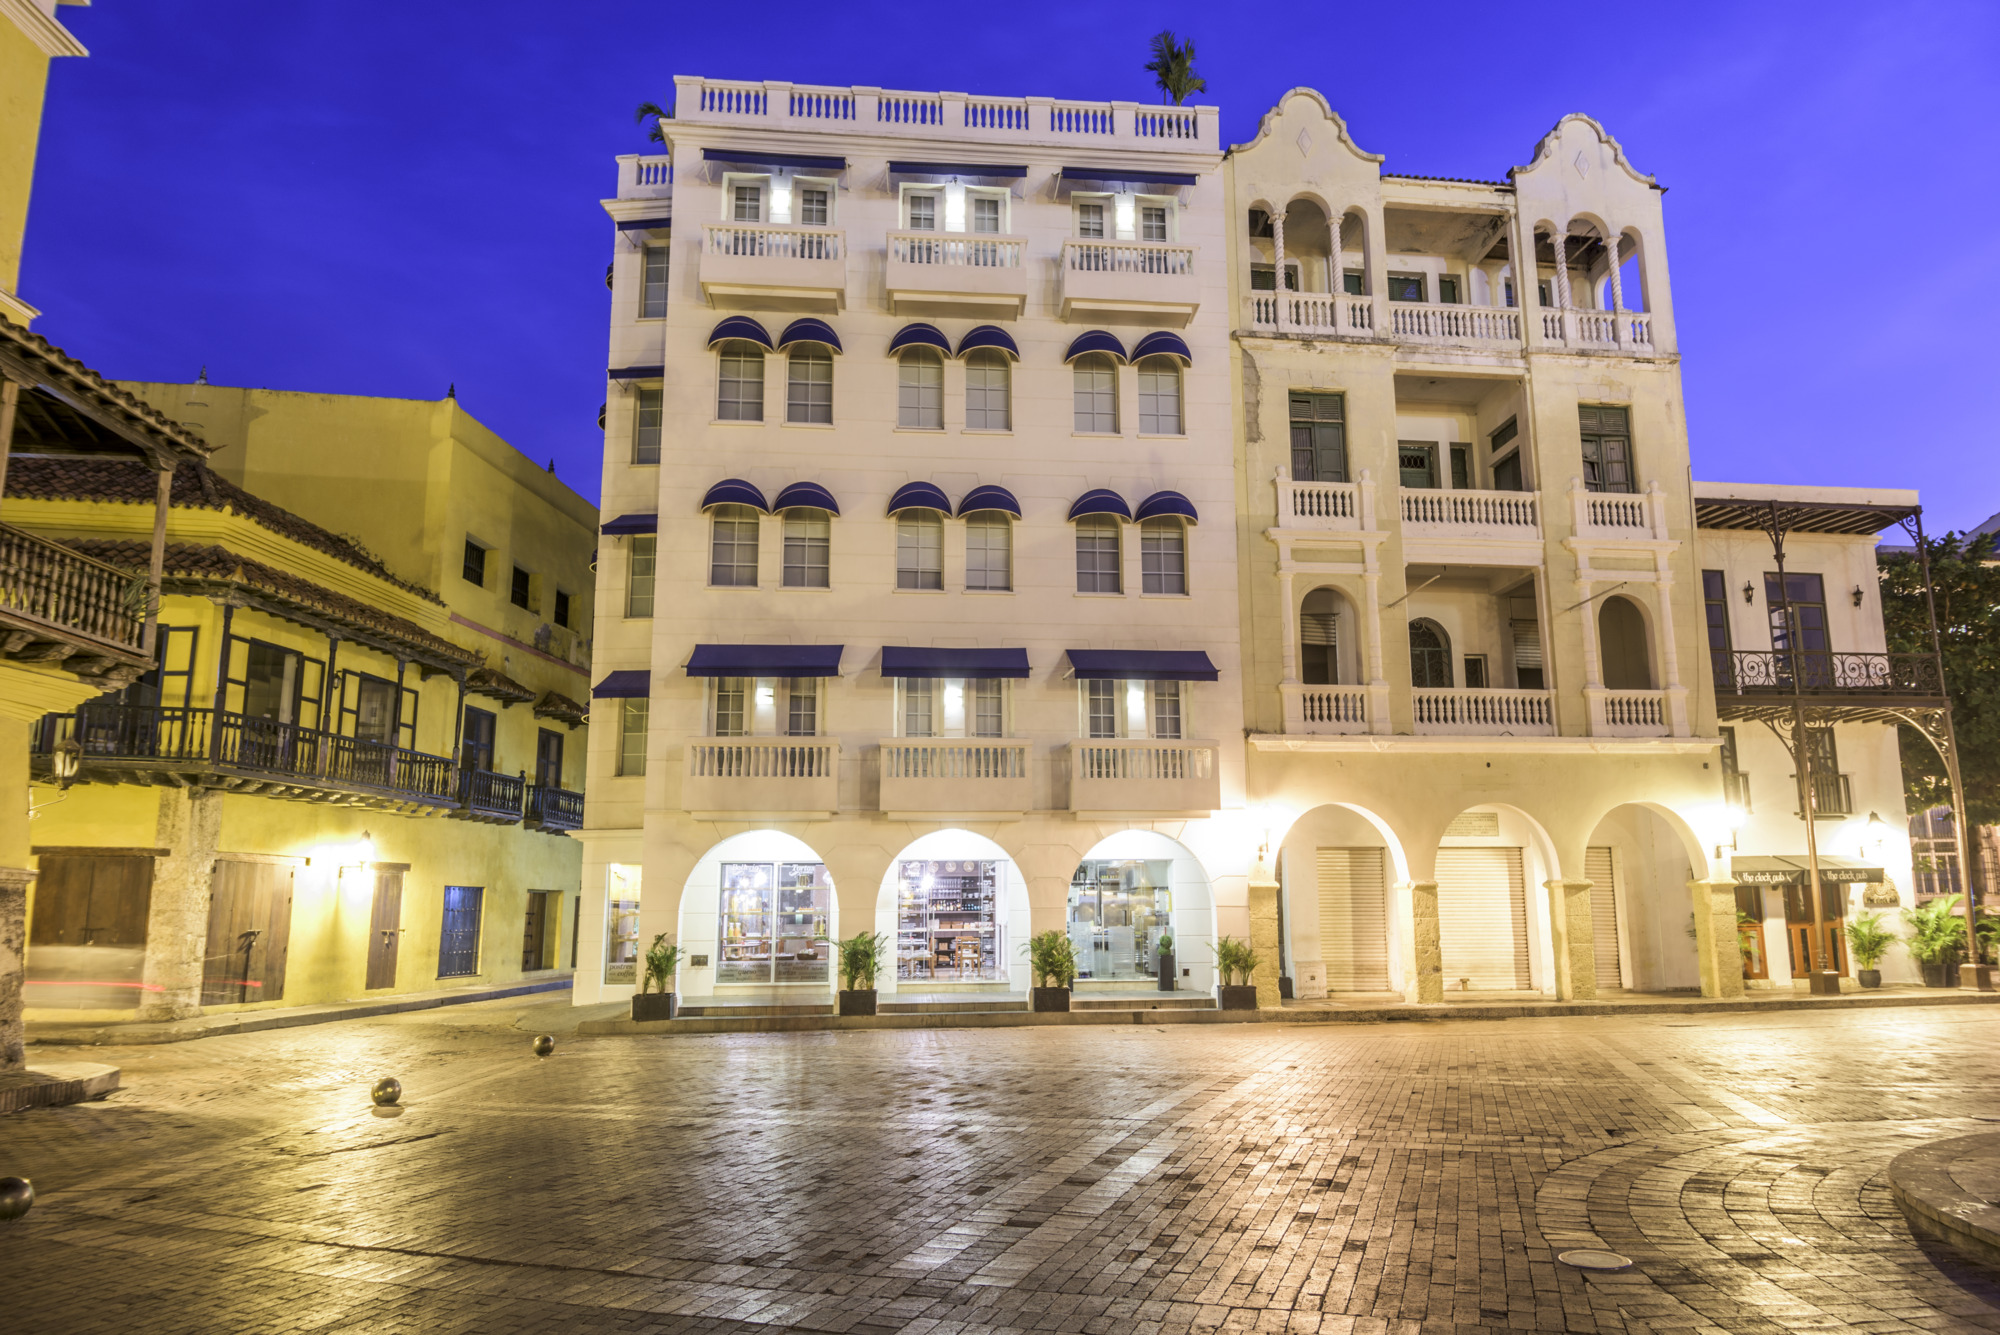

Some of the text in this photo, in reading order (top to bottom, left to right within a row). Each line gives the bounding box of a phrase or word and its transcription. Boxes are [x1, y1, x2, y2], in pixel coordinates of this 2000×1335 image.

[1742, 871, 1785, 884] the clock pub
[1826, 870, 1868, 881] the clock pub
